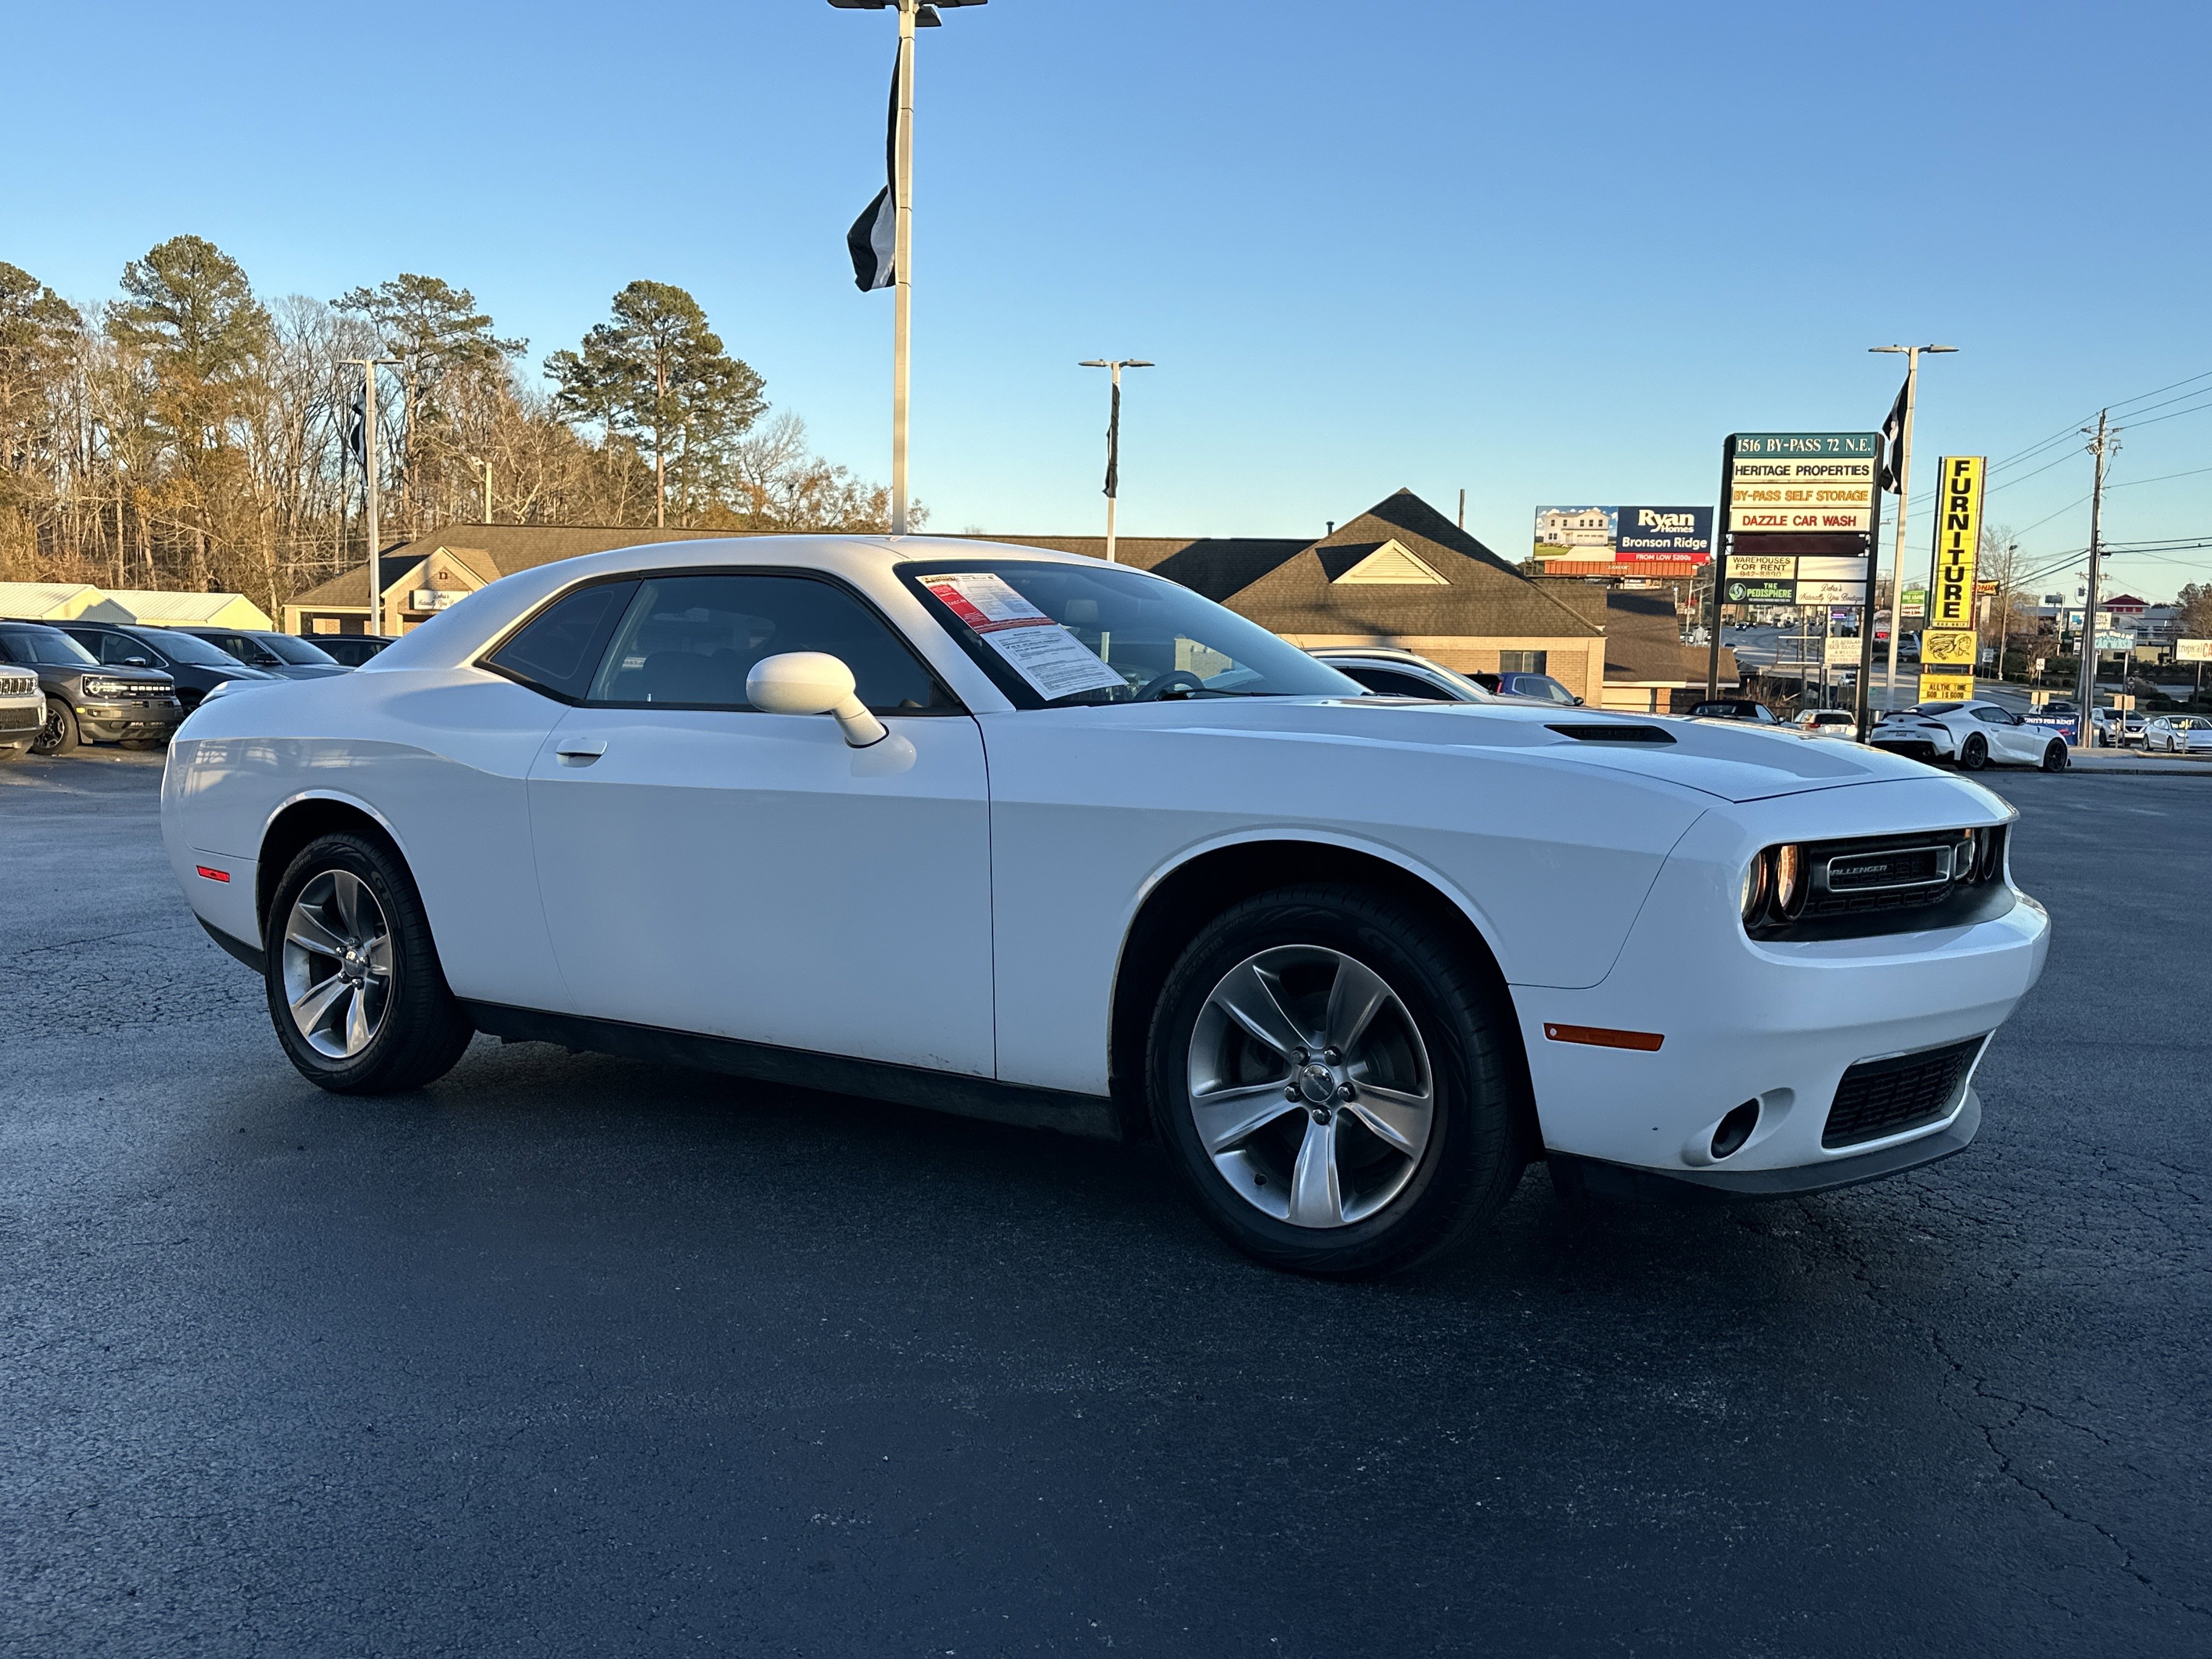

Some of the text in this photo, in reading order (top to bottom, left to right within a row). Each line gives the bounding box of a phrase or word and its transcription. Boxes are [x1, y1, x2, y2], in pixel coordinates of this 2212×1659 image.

[1737, 438, 1871, 452] 1516 BY-PASS 72 N.E.
[1735, 465, 1870, 476] HERITAGE PROPERTIES
[1733, 490, 1869, 501] BY-PASS SELF STORAGE
[1638, 509, 1695, 533] Ryan
[1742, 515, 1857, 526] DAZZLE CAR WASH
[1622, 537, 1707, 550] Bronson Ridge
[1943, 460, 1971, 619] FURNITURE
[1747, 589, 1793, 597] PEDISPHERE
[1830, 865, 1887, 876] ALLENGER
